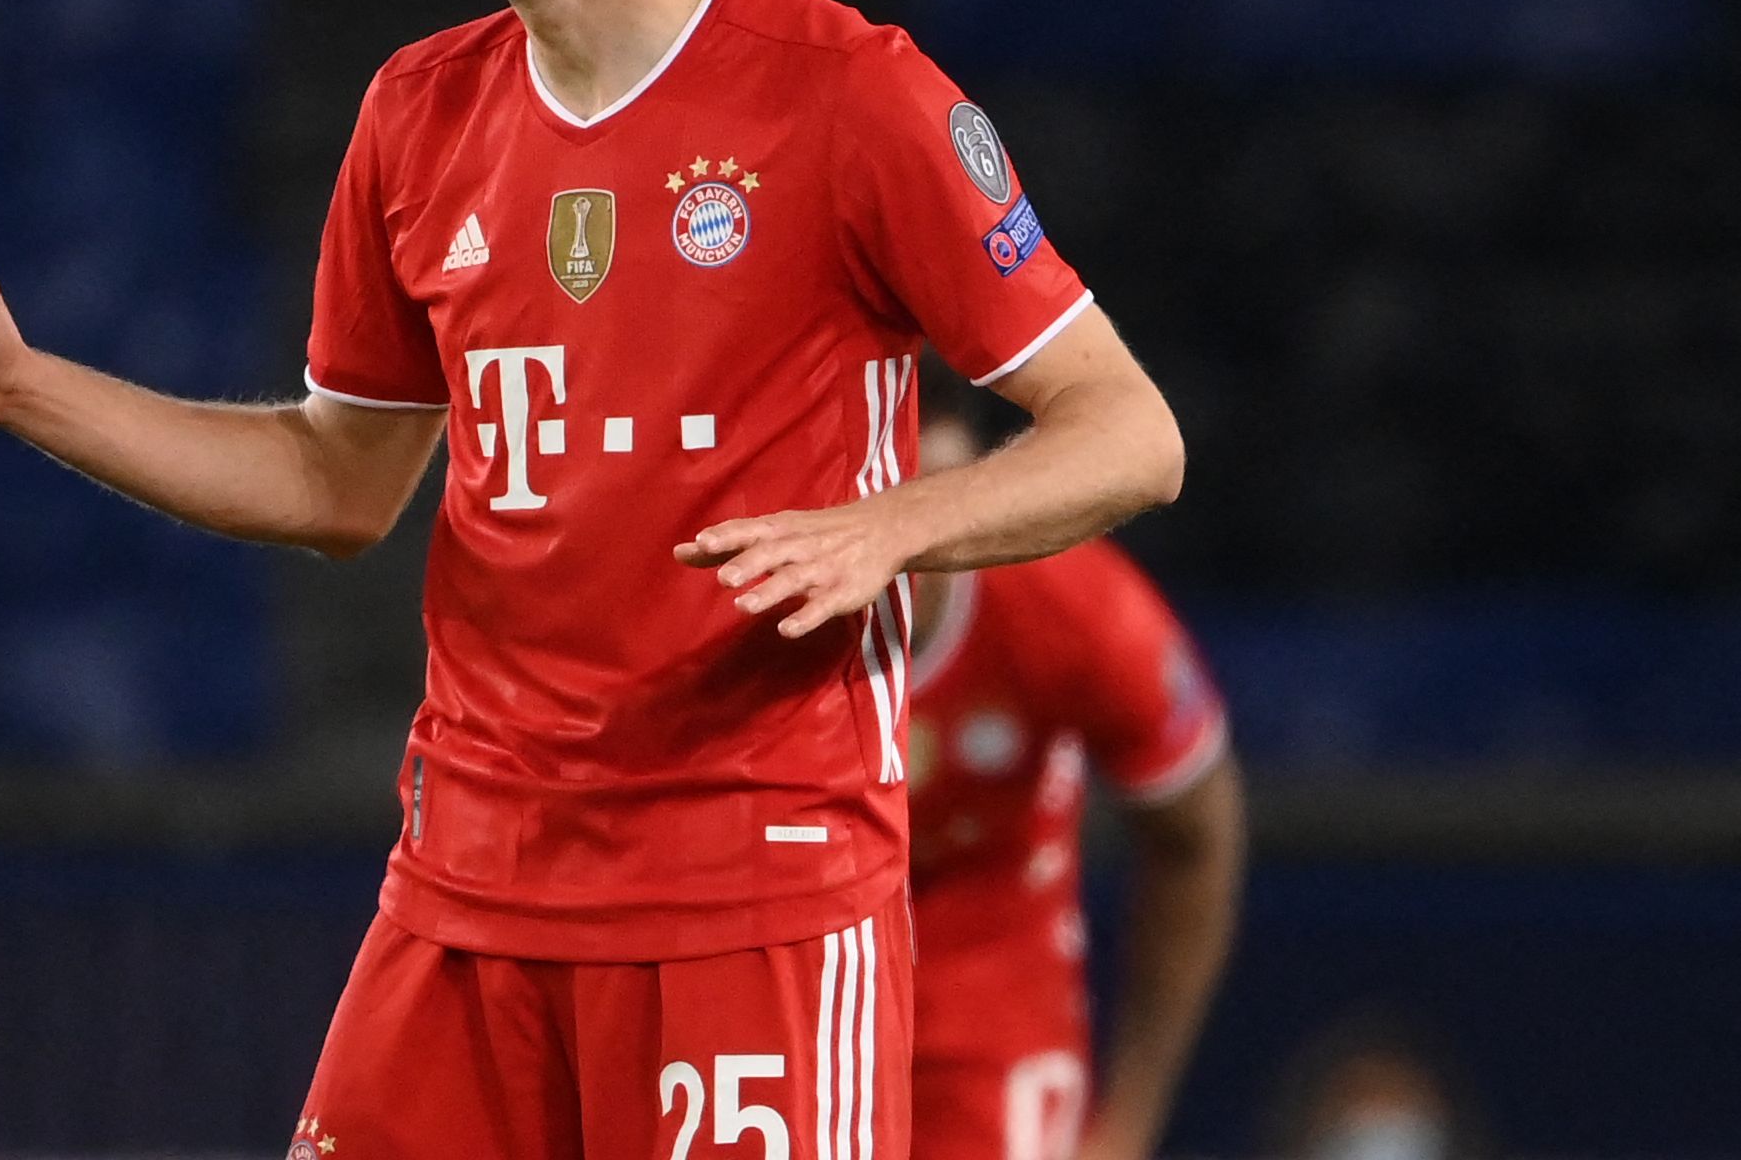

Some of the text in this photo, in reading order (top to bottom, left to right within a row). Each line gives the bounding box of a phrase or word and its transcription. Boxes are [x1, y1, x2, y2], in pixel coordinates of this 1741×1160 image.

[980, 152, 994, 176] 6
[679, 188, 743, 220] FC BAYERN
[566, 260, 594, 274] FIFA
[659, 1054, 791, 1160] 25
